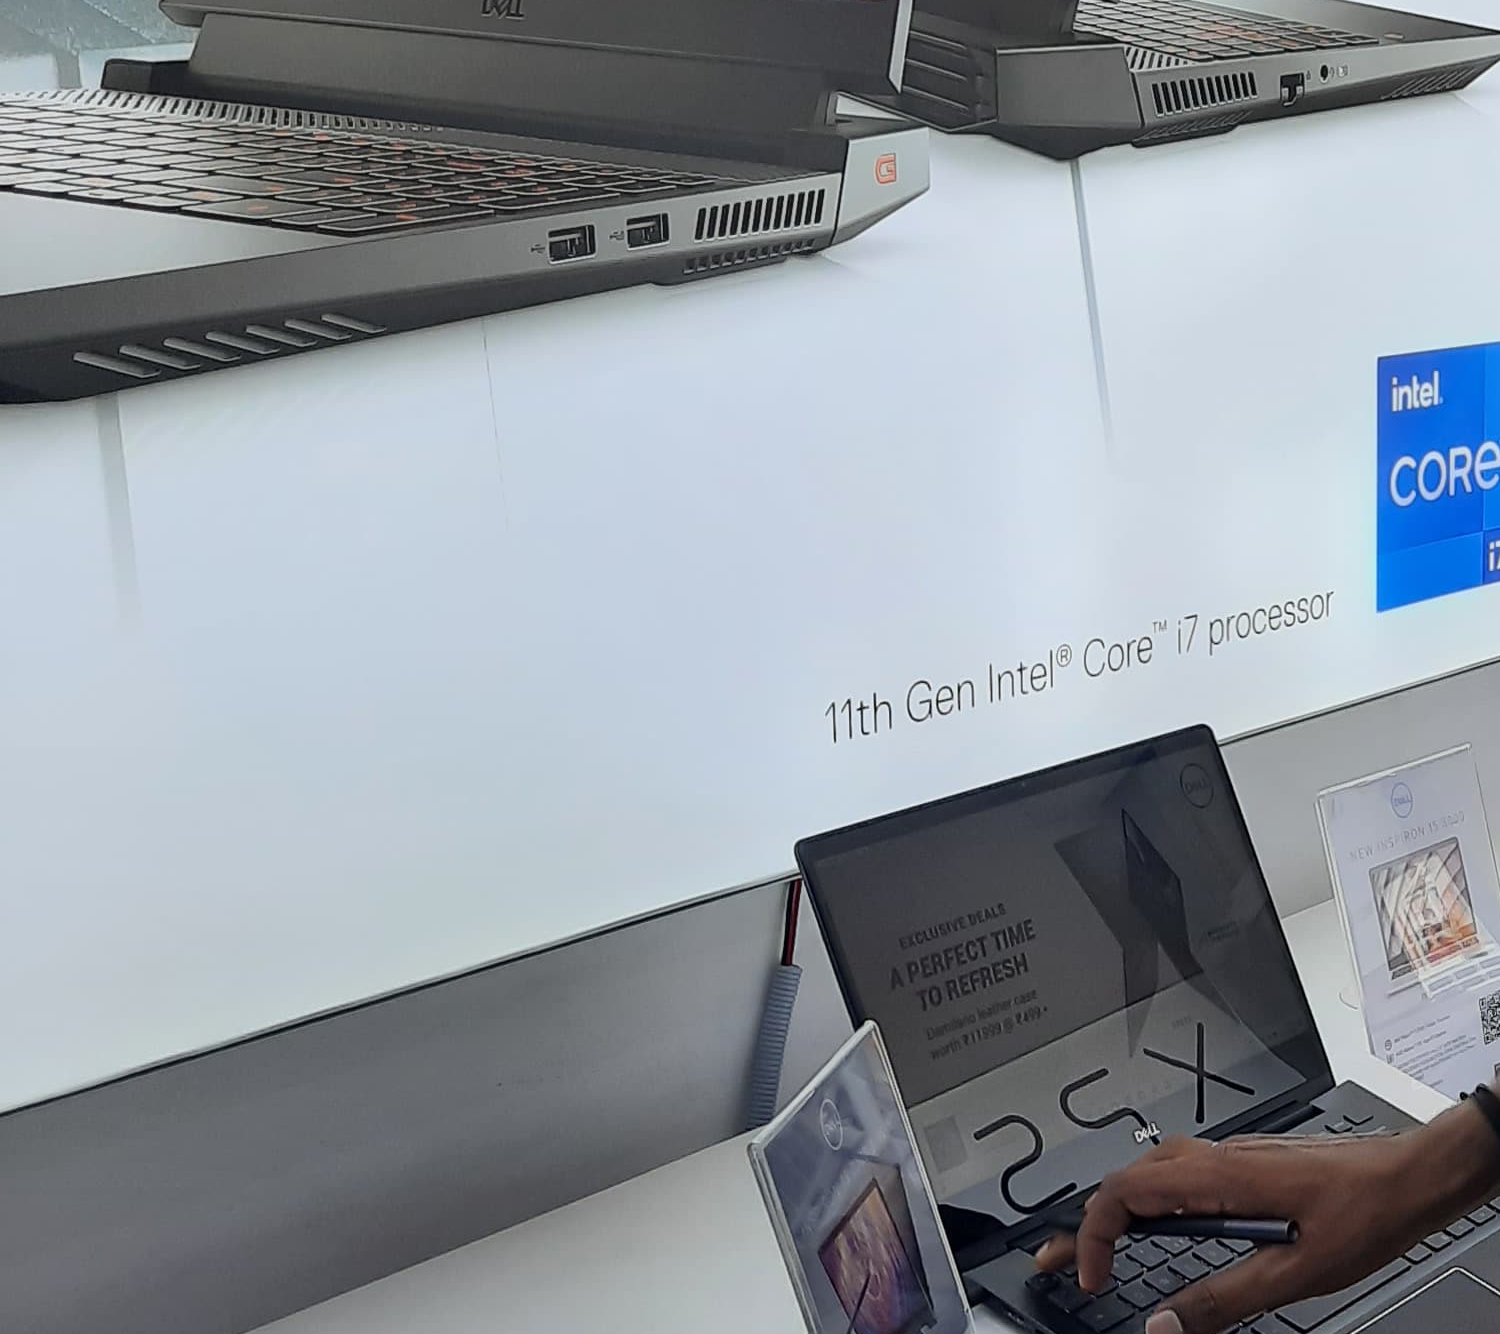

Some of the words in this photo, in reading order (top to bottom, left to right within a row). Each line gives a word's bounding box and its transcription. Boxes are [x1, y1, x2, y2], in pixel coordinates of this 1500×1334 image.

[1390, 370, 1443, 414] intel
[824, 692, 893, 745] 11th
[904, 671, 977, 726] Gen
[1175, 615, 1199, 656] i7
[1207, 587, 1336, 653] processor
[889, 967, 905, 991] A
[906, 935, 988, 983] PERFECT
[990, 919, 1037, 952] TIME
[899, 917, 968, 950] EXCLUSIVE
[967, 903, 1007, 927] DEALS
[916, 985, 943, 1012] TO
[945, 952, 1029, 1002] REFRESH
